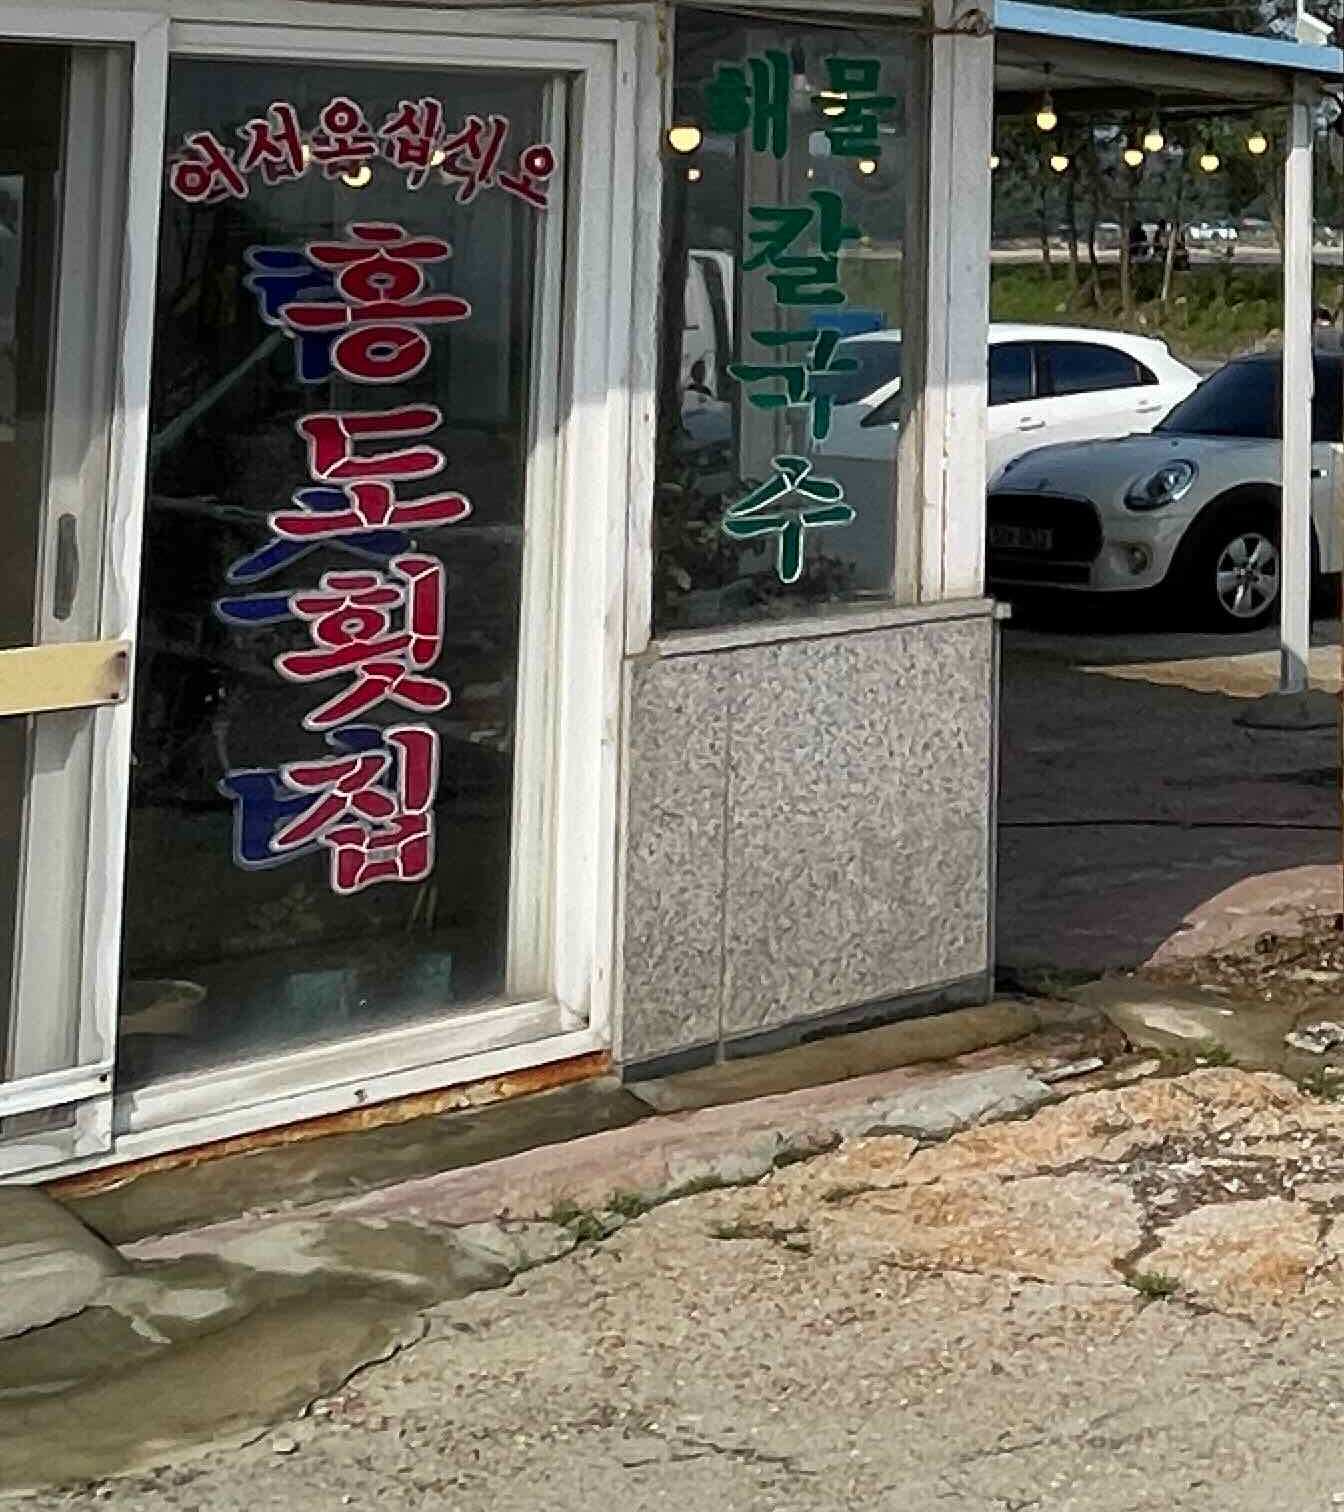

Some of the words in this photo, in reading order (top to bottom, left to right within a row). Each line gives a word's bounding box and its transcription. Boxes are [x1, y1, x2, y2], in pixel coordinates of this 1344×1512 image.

[170, 97, 558, 209] 어서오십시오
[269, 221, 474, 894] 홍도횟집
[721, 188, 865, 584] 칼국수
